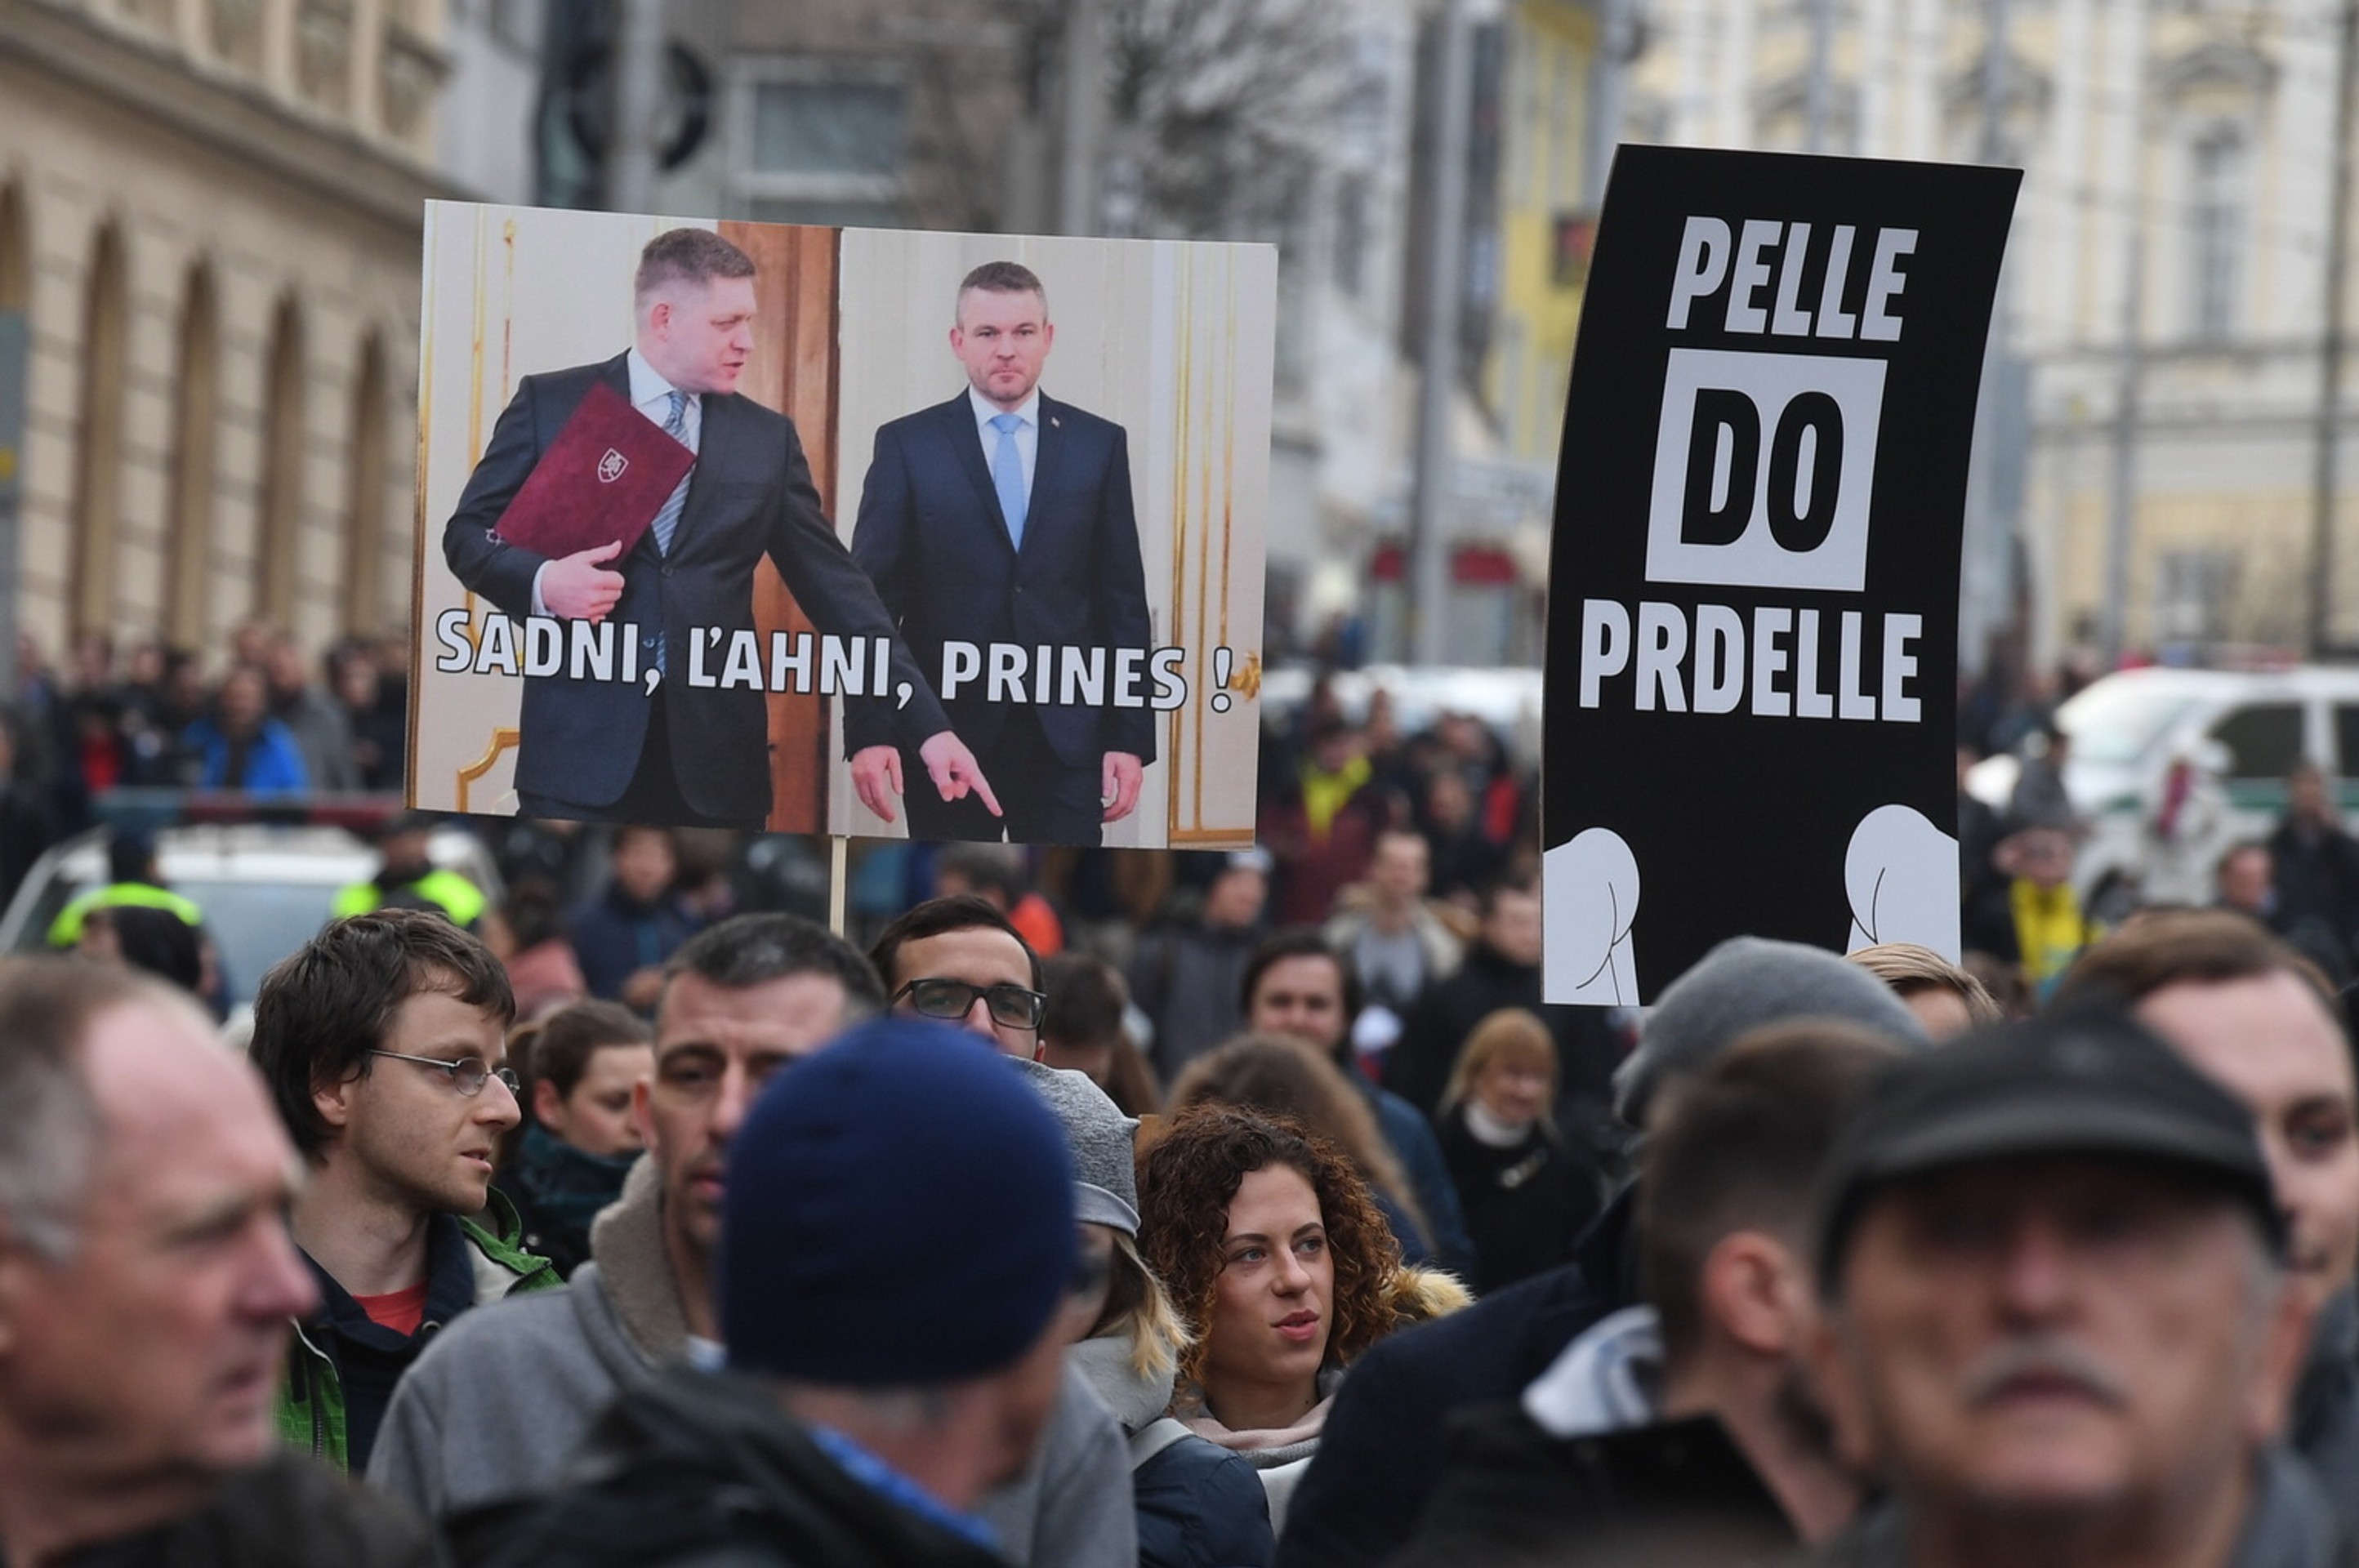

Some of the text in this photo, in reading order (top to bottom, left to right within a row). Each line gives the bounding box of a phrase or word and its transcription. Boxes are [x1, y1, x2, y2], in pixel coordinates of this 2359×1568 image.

[1666, 216, 1920, 341] PELLE
[1679, 388, 1844, 553] DO
[435, 608, 665, 697] SADNI,
[940, 639, 1188, 712] PRINES
[1578, 599, 1923, 723] PRDELLE
